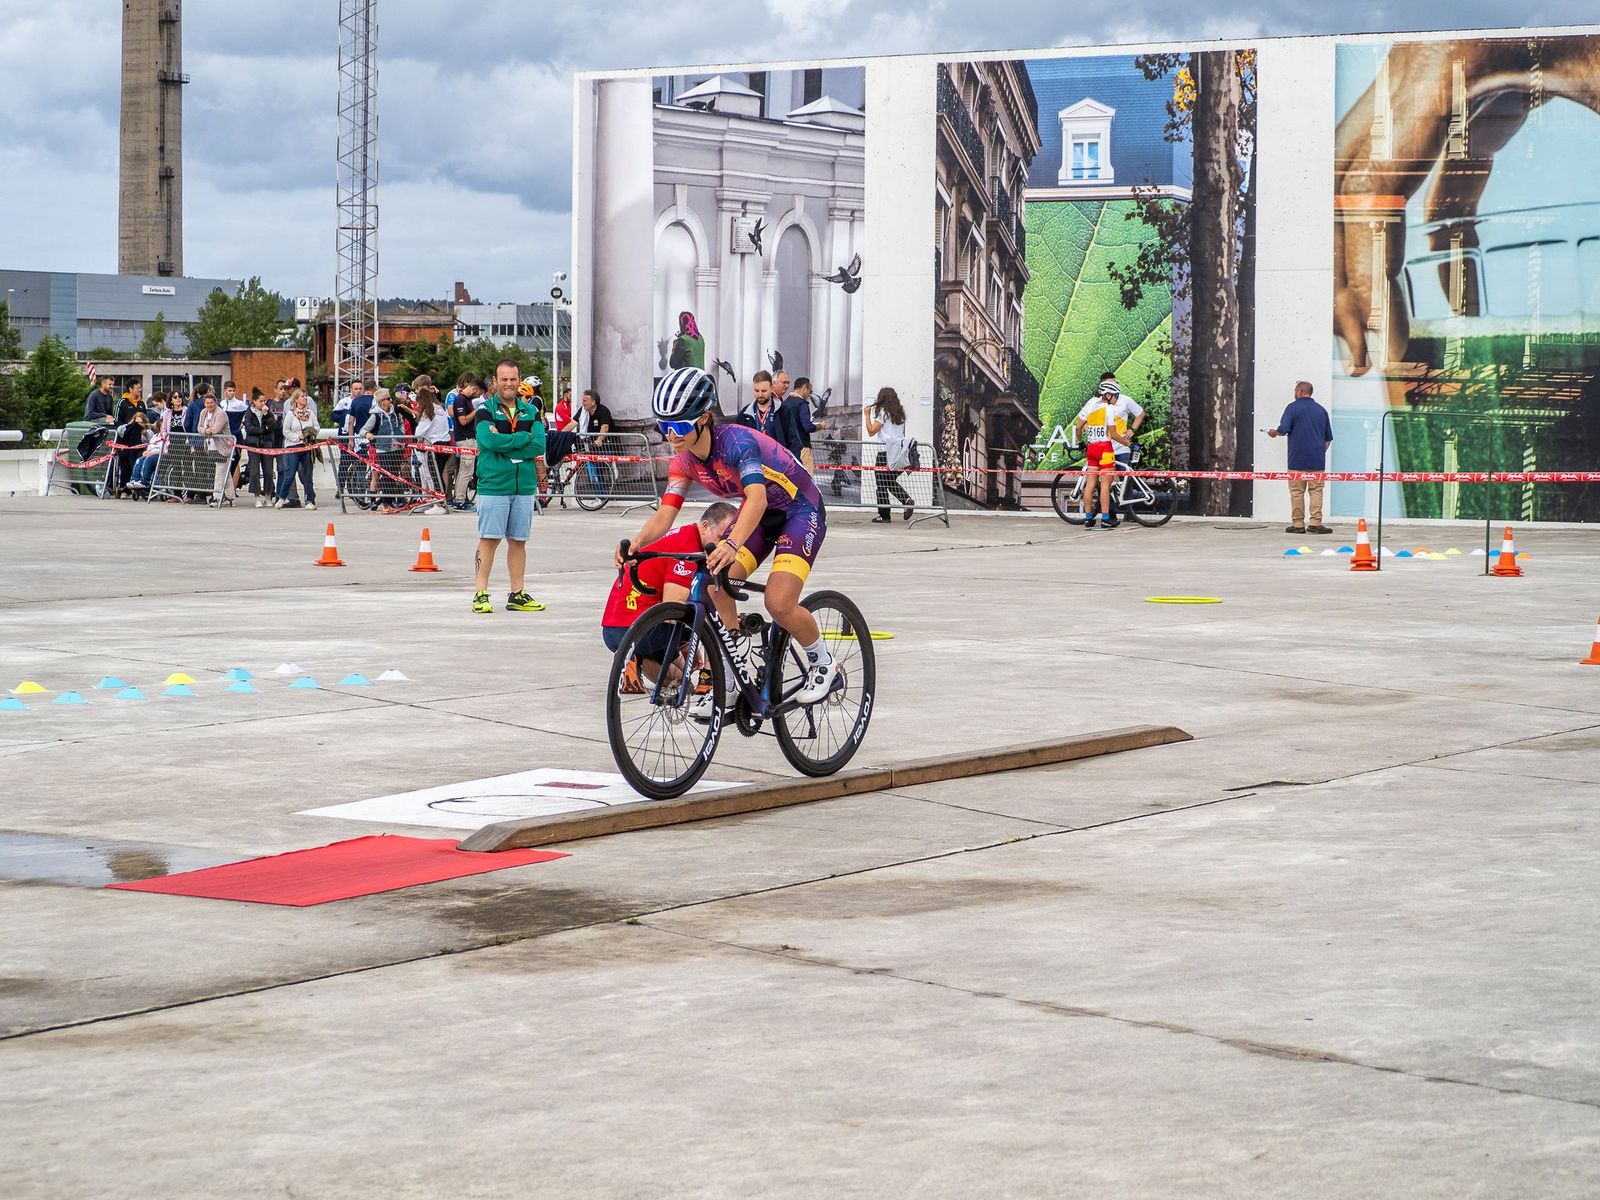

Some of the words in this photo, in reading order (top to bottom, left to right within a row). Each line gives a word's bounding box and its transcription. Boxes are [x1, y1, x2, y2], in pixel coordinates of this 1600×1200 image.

[802, 533, 815, 557] Castilla
[703, 706, 722, 761] roval
[853, 692, 871, 745] roval
